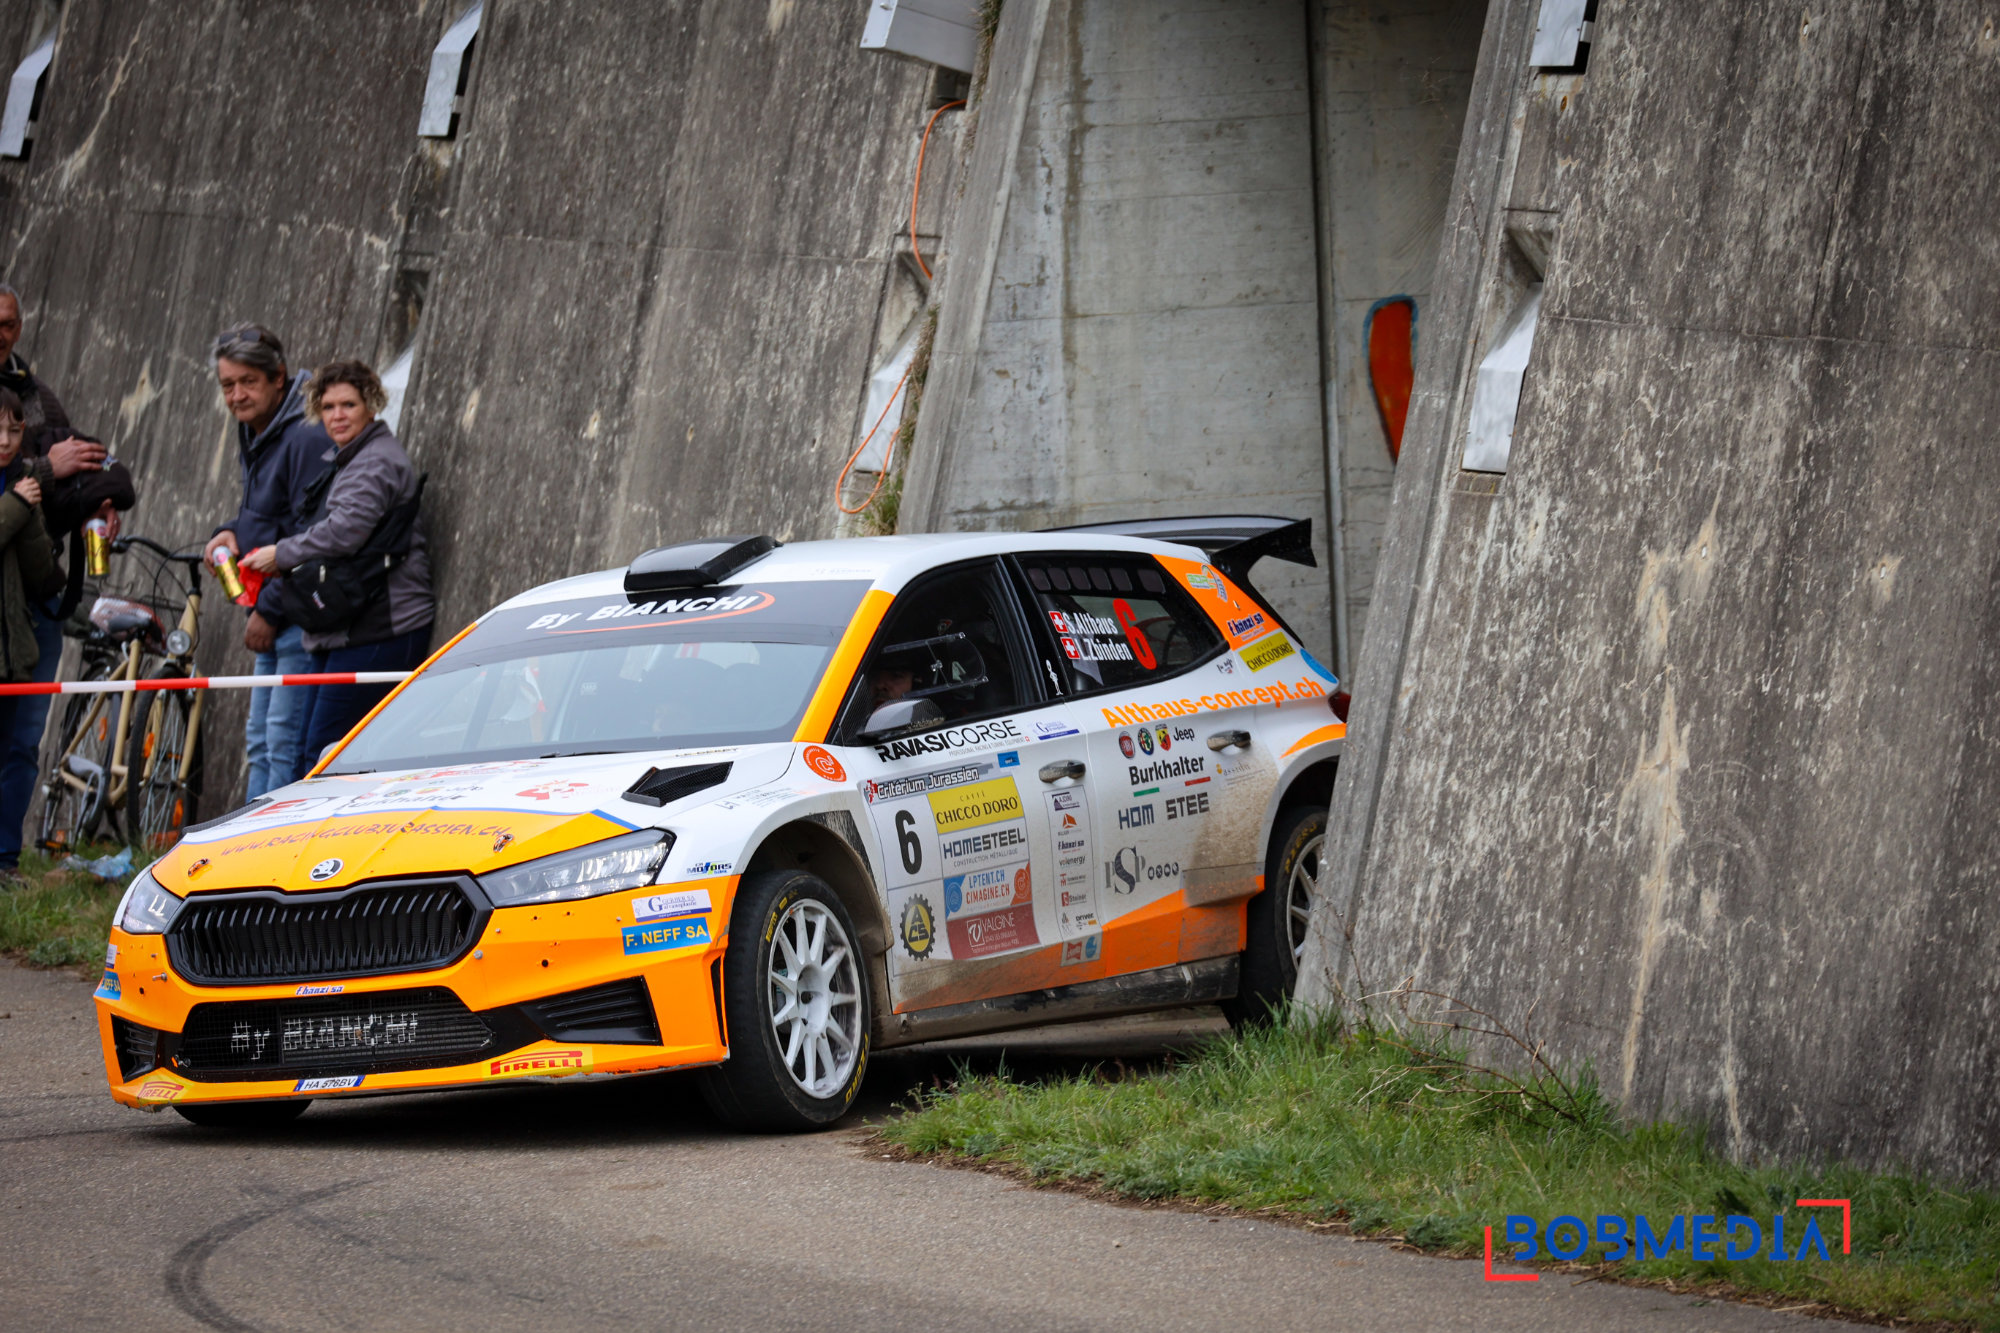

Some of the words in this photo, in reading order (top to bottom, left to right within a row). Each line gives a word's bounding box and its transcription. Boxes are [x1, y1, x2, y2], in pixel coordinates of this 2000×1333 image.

[526, 611, 582, 631] By
[585, 595, 760, 622] BIANCHI
[1063, 610, 1119, 637] S.Althaus
[1112, 597, 1159, 671] 6
[1078, 637, 1134, 663] L.Zbinden
[1101, 676, 1326, 729] Althaus-concept.ch
[875, 719, 1021, 763] RAVASICORSE
[1173, 726, 1196, 743] Jeep
[877, 777, 926, 799] Critérium
[928, 766, 980, 790] Jurassien
[1129, 755, 1205, 786] Burkhalter
[936, 802, 981, 826] CHICCO
[1118, 802, 1156, 830] HOM
[1166, 791, 1210, 820] STEE
[894, 808, 923, 876] 6
[943, 827, 1026, 860] HOMESTEEL
[966, 883, 1010, 905] CIMAGINE.CH
[968, 868, 1005, 889] LPTENT.CH
[626, 933, 638, 947] F.
[641, 927, 681, 945] NEFF
[685, 924, 708, 939] SA
[489, 1050, 583, 1076] PIRELLI
